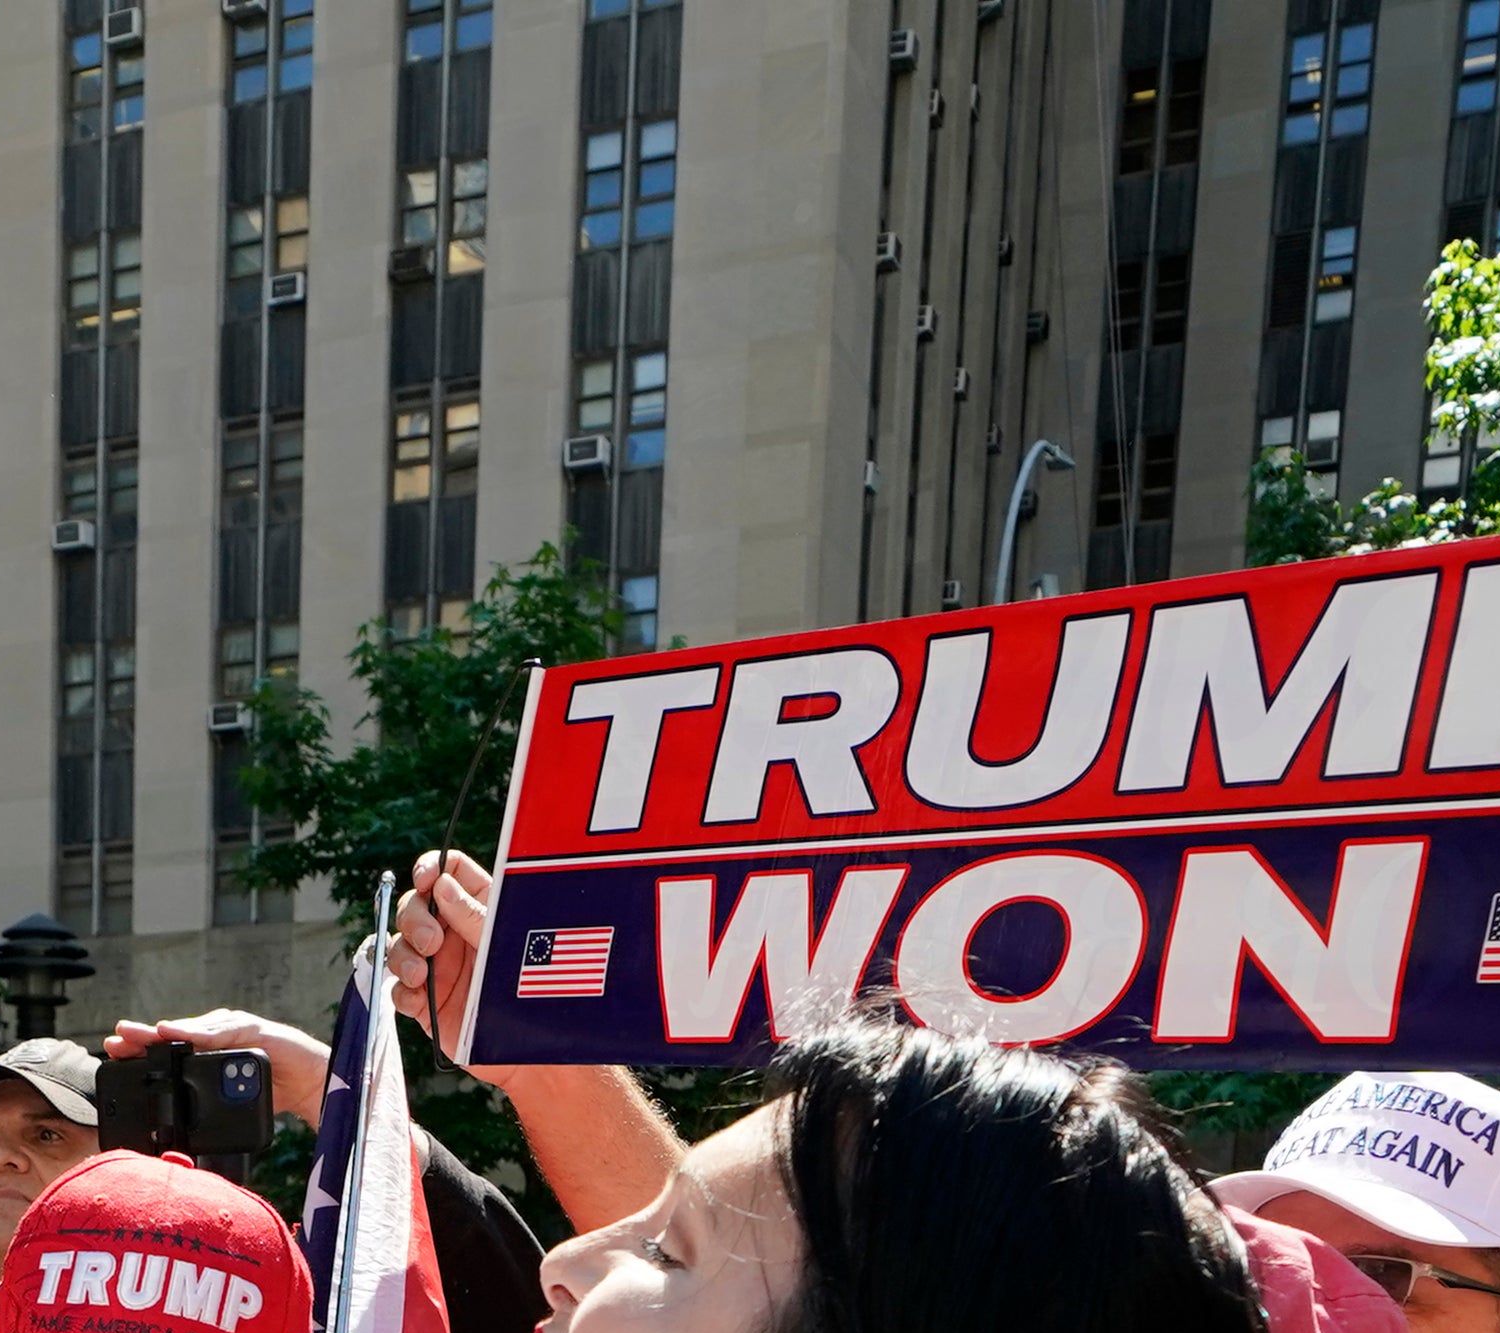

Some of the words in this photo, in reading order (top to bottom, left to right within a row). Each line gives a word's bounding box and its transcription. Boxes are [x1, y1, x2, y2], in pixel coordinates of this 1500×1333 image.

[655, 837, 1431, 1047] WON
[1344, 1082, 1500, 1156] AMERICA
[1344, 1125, 1465, 1189] AGAIN
[36, 1249, 264, 1333] TRUMP
